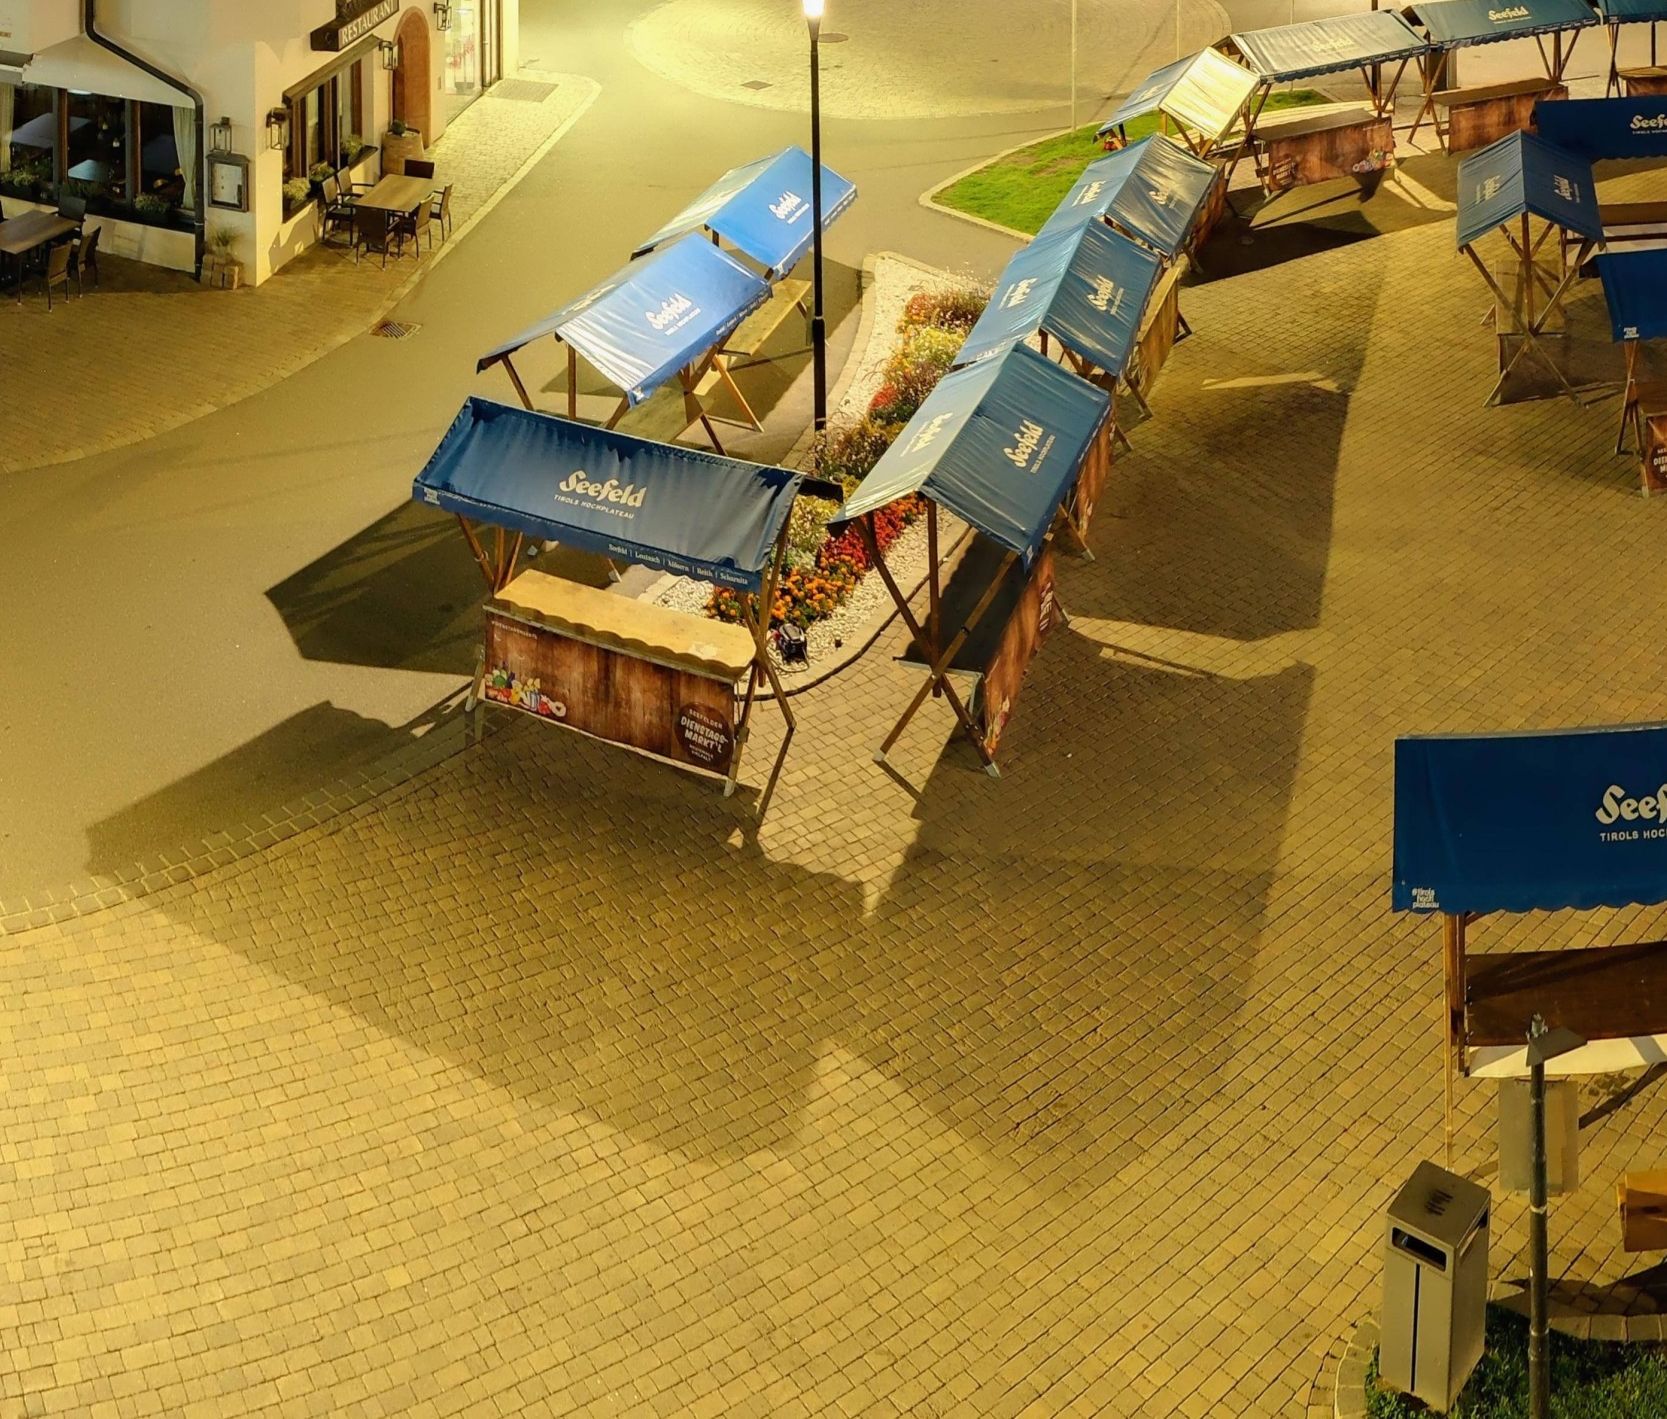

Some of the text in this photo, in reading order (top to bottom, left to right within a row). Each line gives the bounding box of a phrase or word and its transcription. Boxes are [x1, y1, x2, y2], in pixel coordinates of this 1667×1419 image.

[1489, 6, 1529, 21] Seefeld
[769, 191, 802, 220] Seefeld
[645, 292, 693, 330] Seefeld
[1003, 418, 1044, 469] Seefeld
[559, 469, 648, 509] Seefeld
[553, 494, 635, 520] TIROLS HOCHPLATEAU
[608, 543, 628, 555] Seefeld
[680, 715, 730, 744] DIENSTAGS-
[689, 708, 724, 730] SEEFELDER
[1599, 830, 1639, 842] TIROLS
